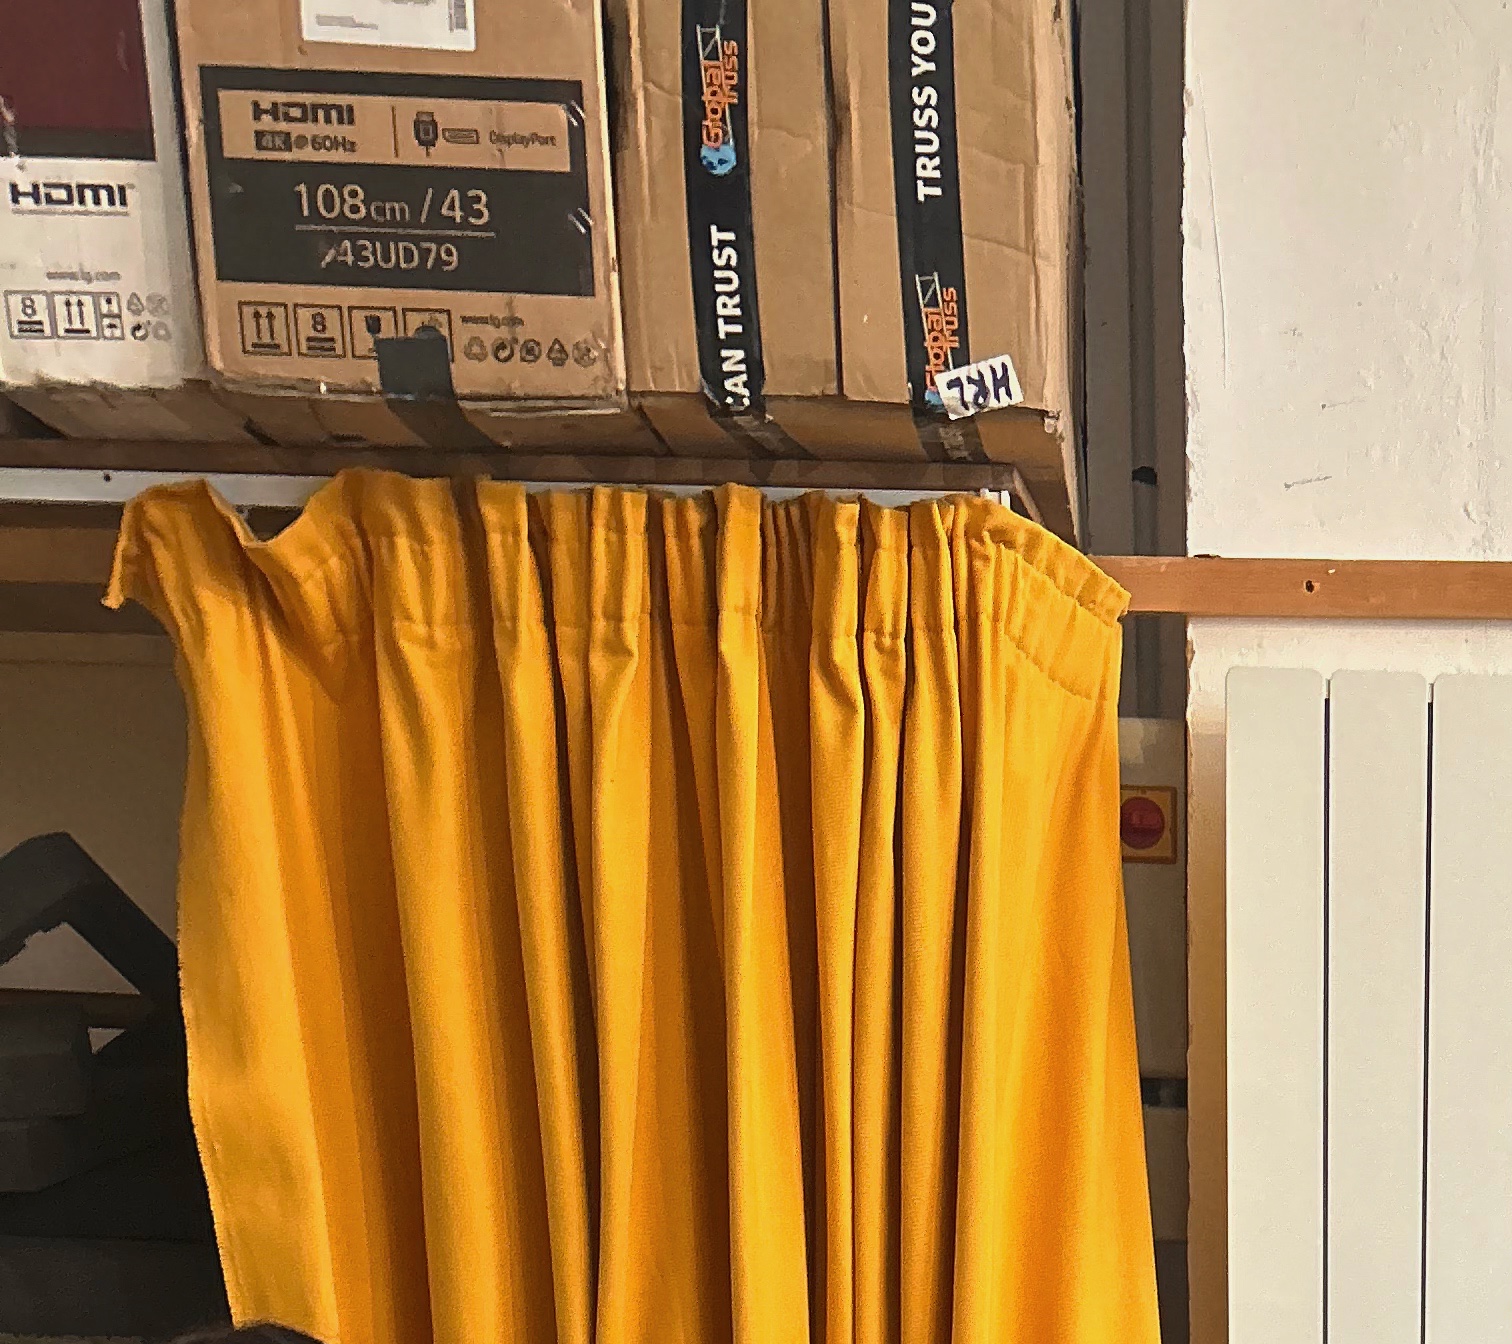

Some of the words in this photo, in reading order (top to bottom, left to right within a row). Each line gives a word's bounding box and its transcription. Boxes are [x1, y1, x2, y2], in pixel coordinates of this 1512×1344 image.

[911, 0, 938, 77] YOU
[252, 100, 356, 126] HDMI
[912, 88, 944, 203] TRUSS
[9, 182, 128, 207] HDMI
[294, 182, 411, 222] 108cm
[441, 188, 490, 226] 43
[709, 224, 745, 341] TRUST
